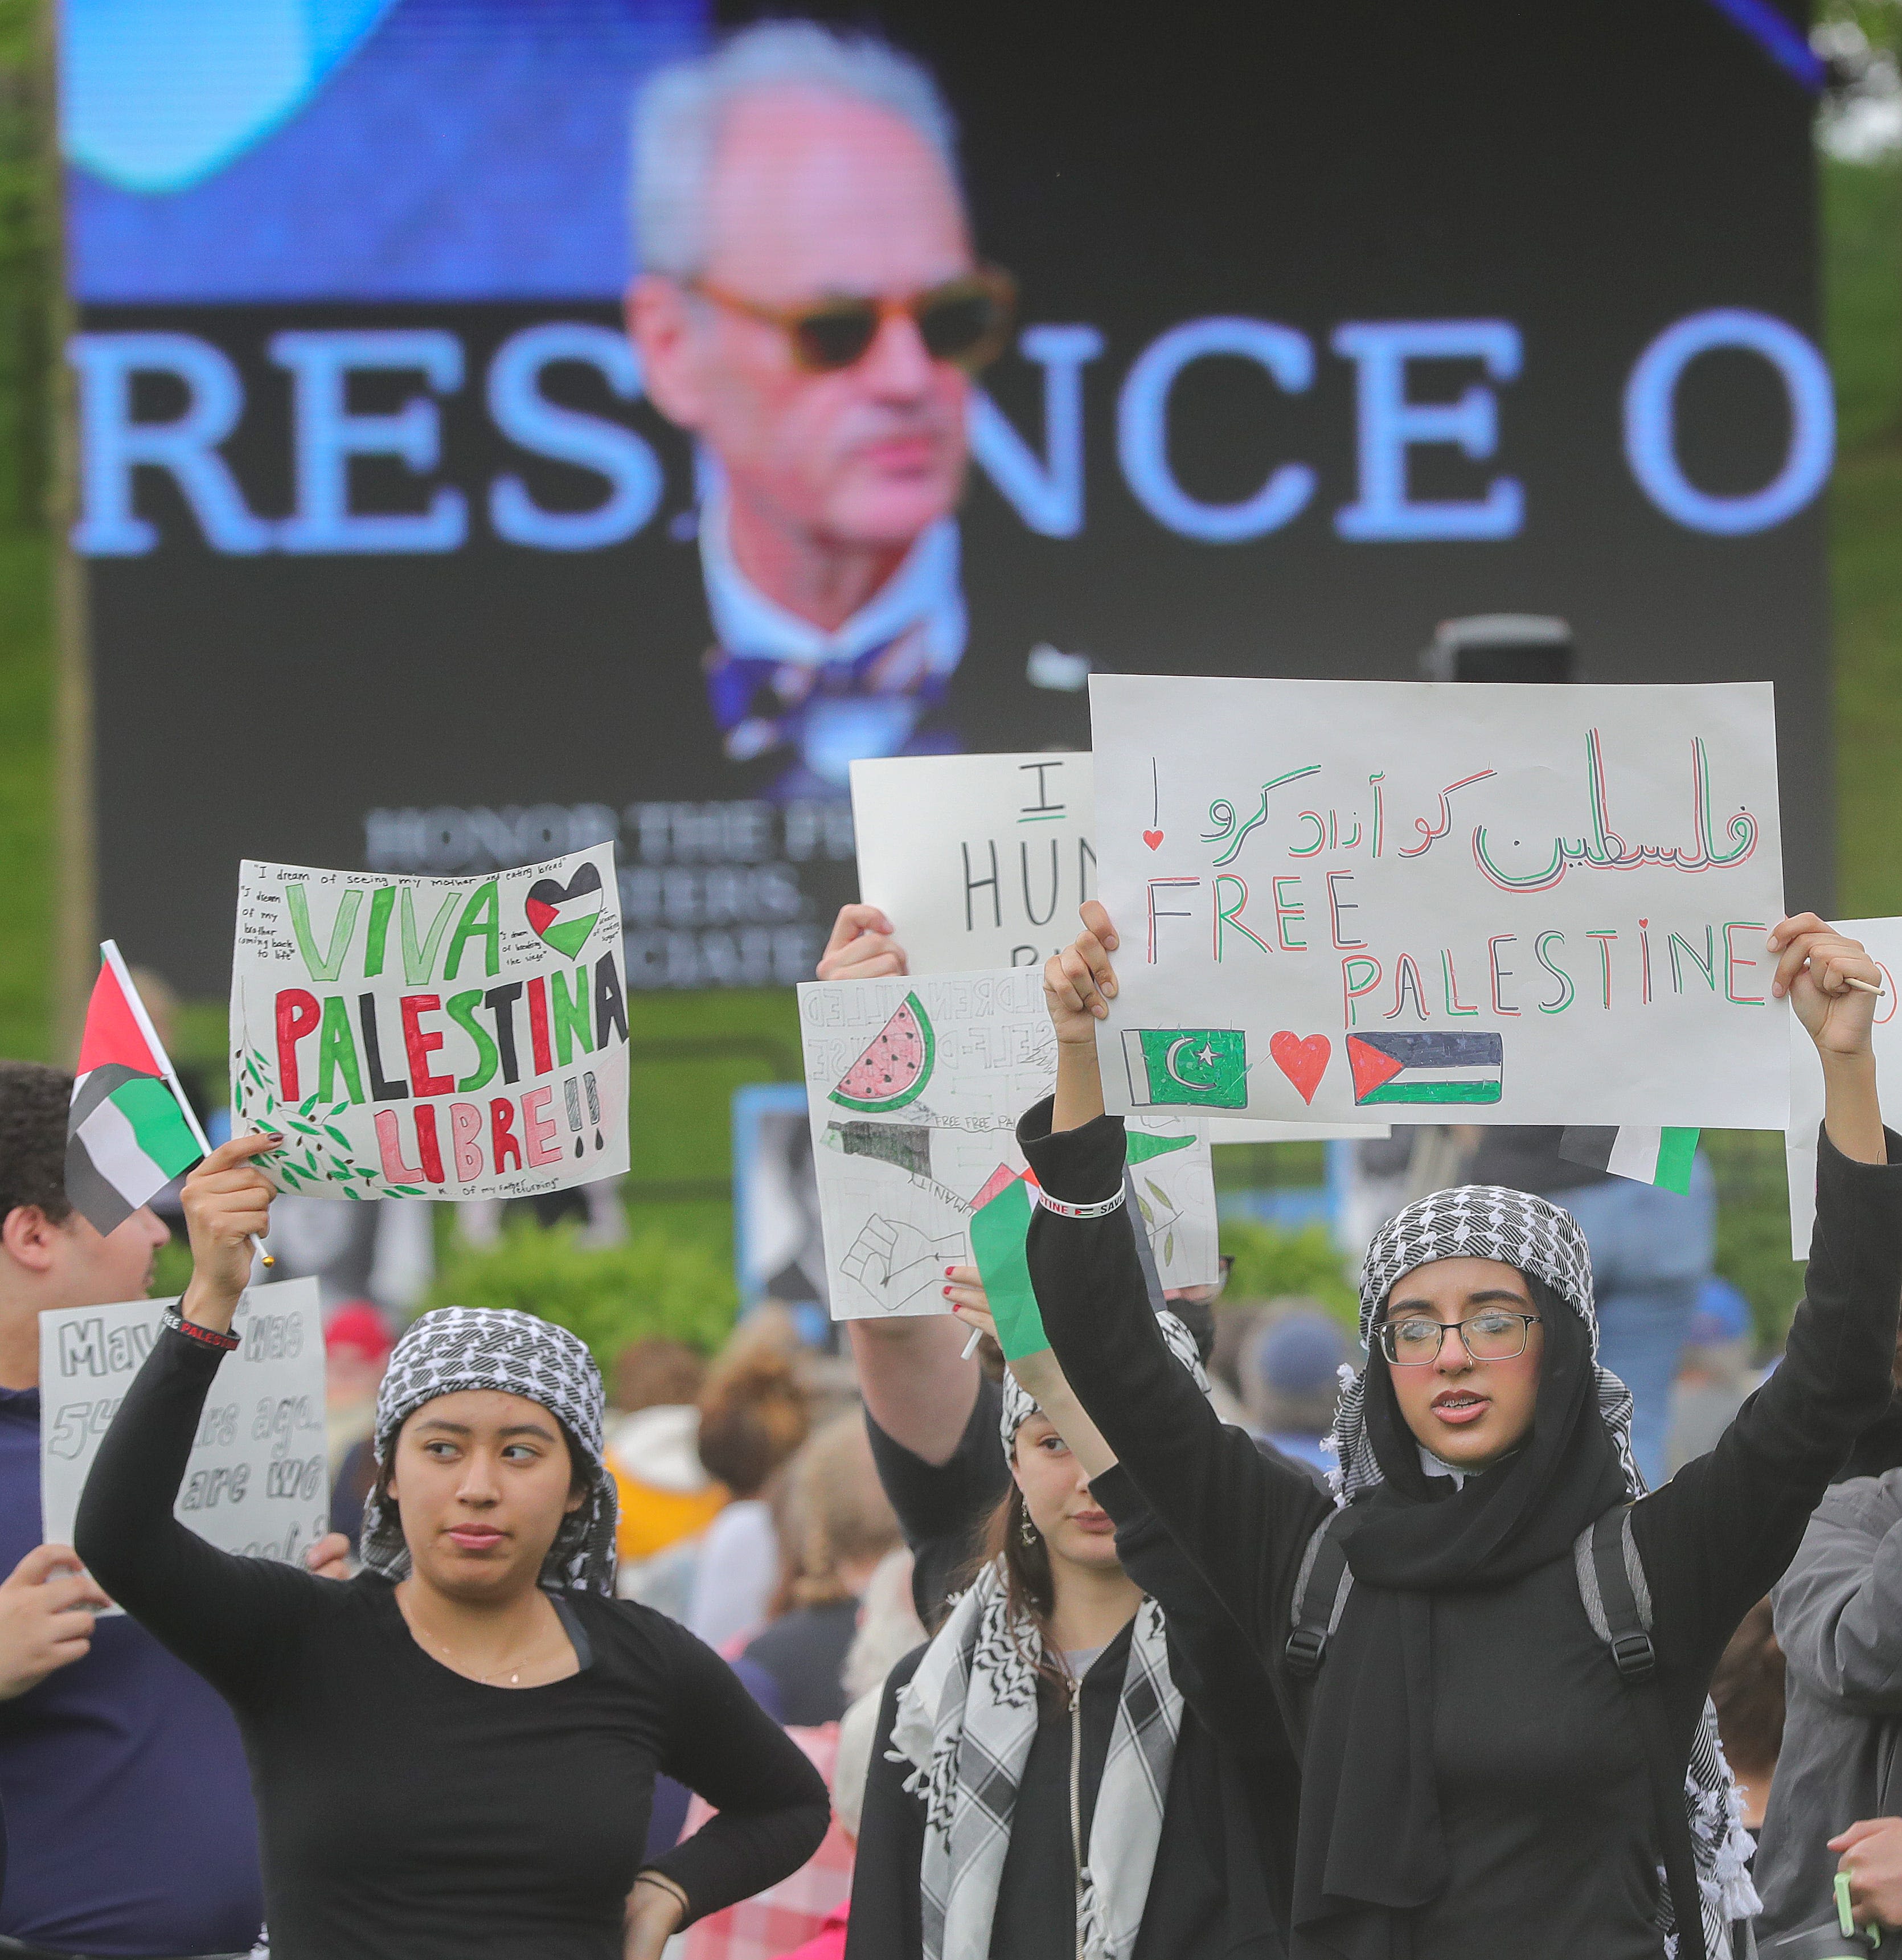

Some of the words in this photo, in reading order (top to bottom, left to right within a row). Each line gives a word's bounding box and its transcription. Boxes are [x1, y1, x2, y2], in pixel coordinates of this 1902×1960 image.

[64, 313, 1525, 556] RESNCE
[1018, 761, 1066, 812] I
[276, 869, 311, 882] dream
[321, 874, 337, 884] of
[346, 874, 388, 887] seeing
[398, 878, 421, 888] my
[261, 912, 278, 922] my
[284, 881, 501, 986] VIVA
[1146, 869, 1369, 964] FREE
[257, 949, 268, 958] to
[274, 949, 629, 1105] PALESTINA
[374, 1071, 605, 1184] LIBRE!!
[934, 1116, 961, 1127] FREE
[965, 1117, 991, 1129] FREE
[907, 1172, 978, 1219] UMANITY
[1100, 1191, 1125, 1214] SAVE
